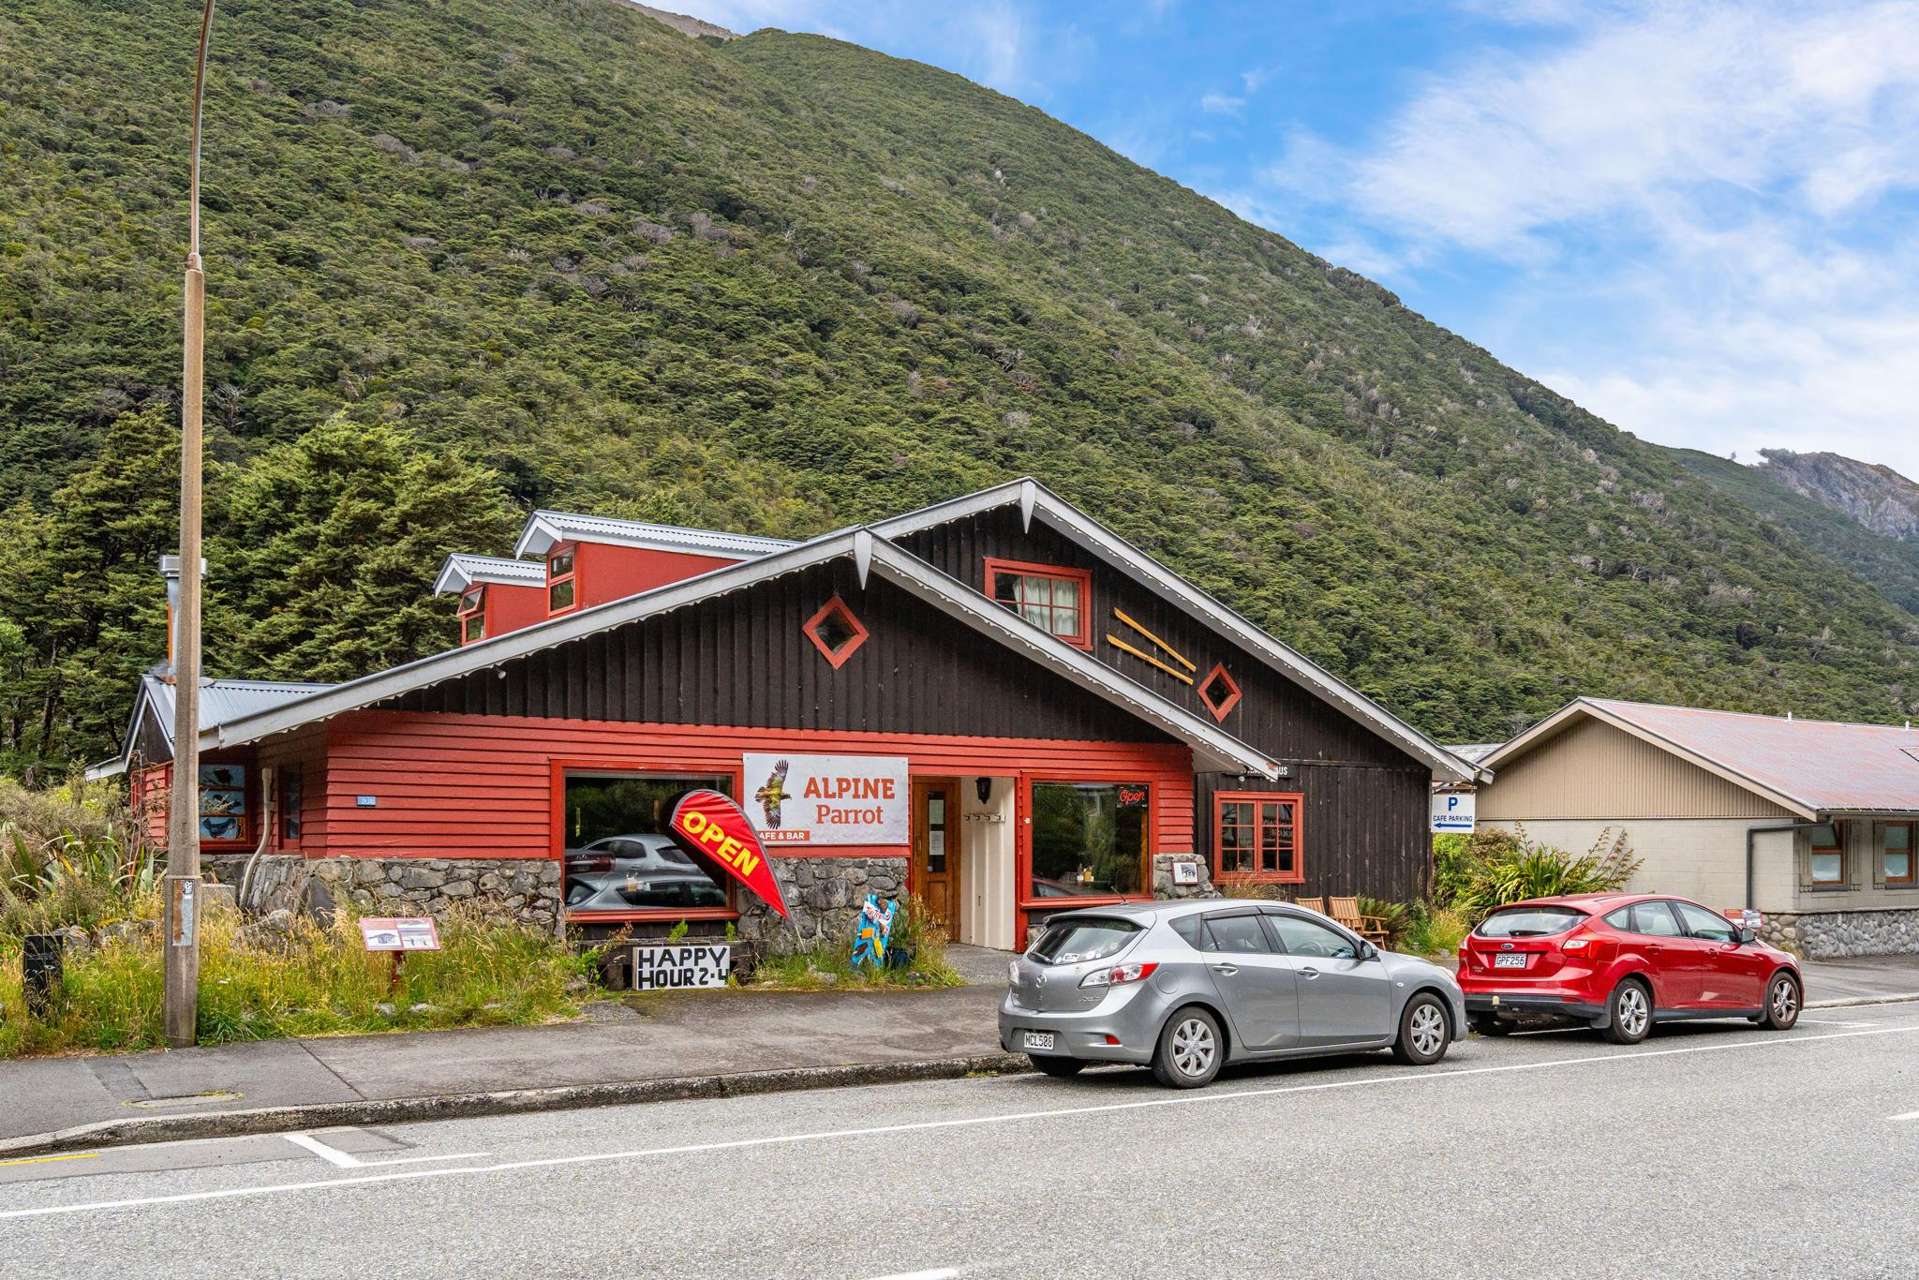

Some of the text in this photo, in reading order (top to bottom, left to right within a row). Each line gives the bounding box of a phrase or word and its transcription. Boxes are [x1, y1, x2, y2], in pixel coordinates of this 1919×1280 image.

[803, 777, 895, 799] ALPINE
[1119, 789, 1145, 805] Open
[1448, 796, 1458, 811] P
[816, 804, 884, 824] Parrot
[682, 811, 760, 877] OPEN
[759, 831, 805, 840] AFE & BAR
[638, 946, 728, 969] HAPPY
[1496, 956, 1525, 966] GPF256
[638, 968, 695, 989] HOUR
